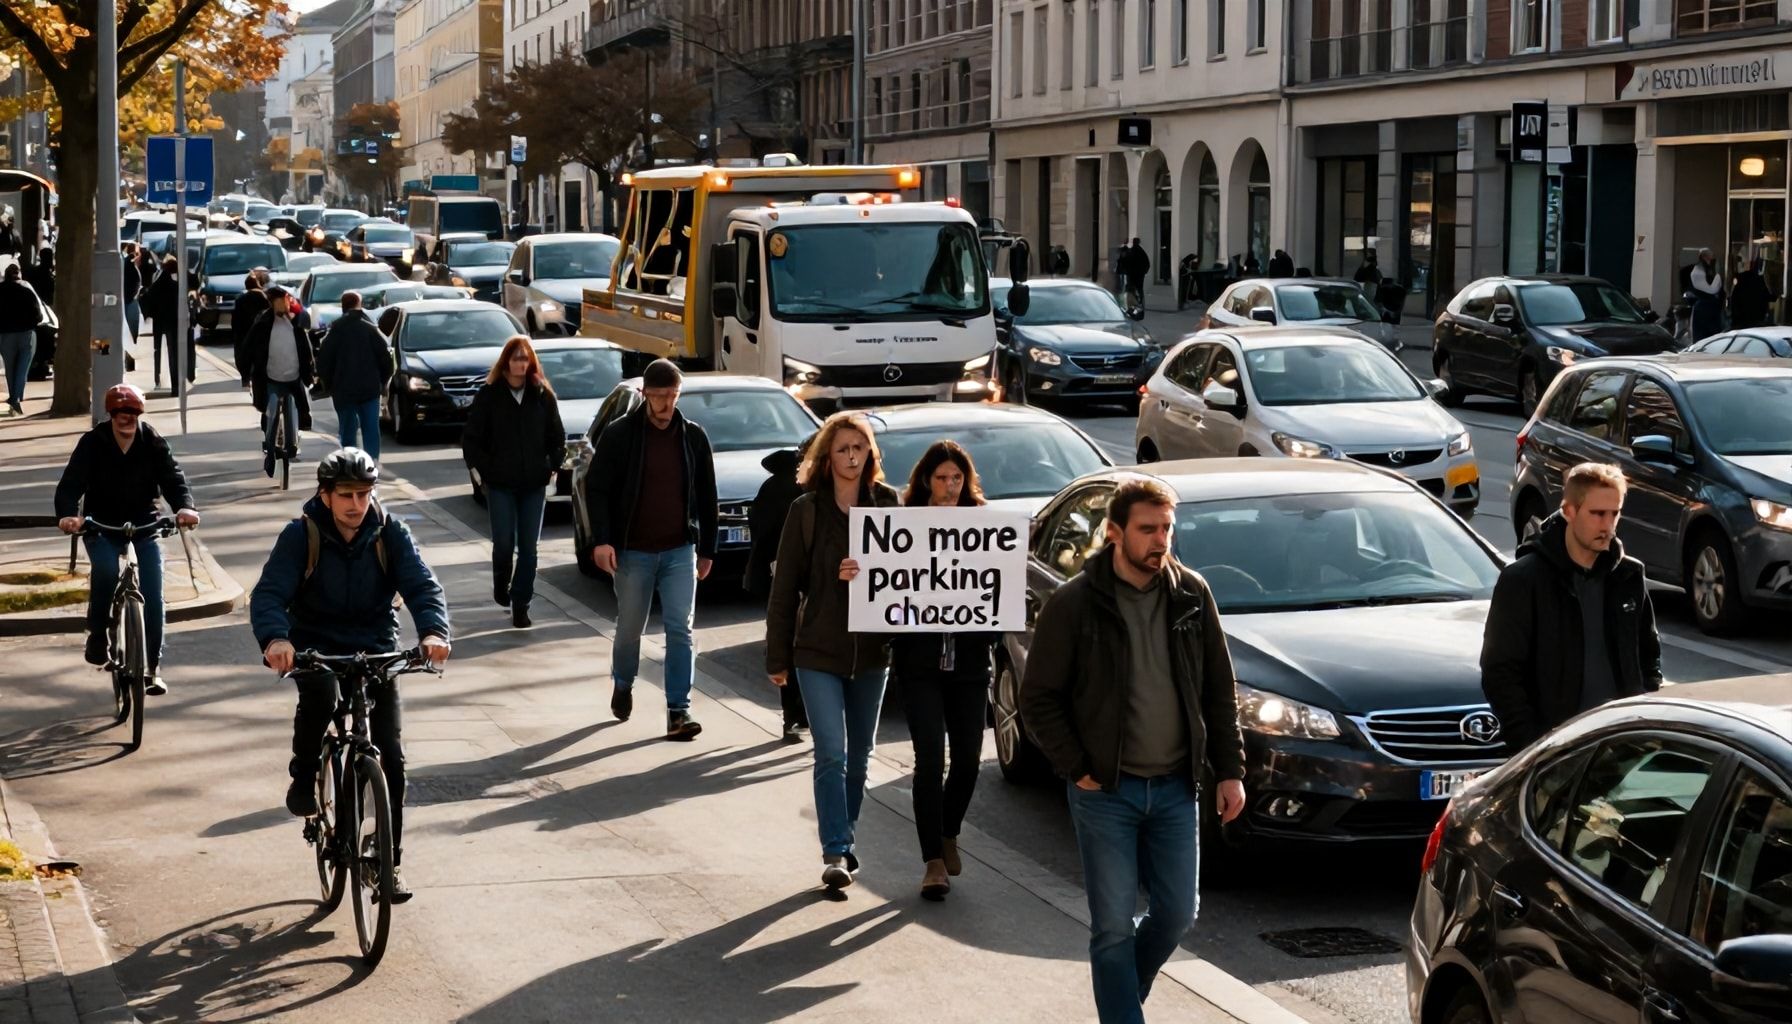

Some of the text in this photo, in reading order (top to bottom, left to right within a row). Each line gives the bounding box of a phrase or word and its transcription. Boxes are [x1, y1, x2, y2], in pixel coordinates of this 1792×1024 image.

[862, 515, 1018, 554] No more
[868, 556, 1001, 602] parking
